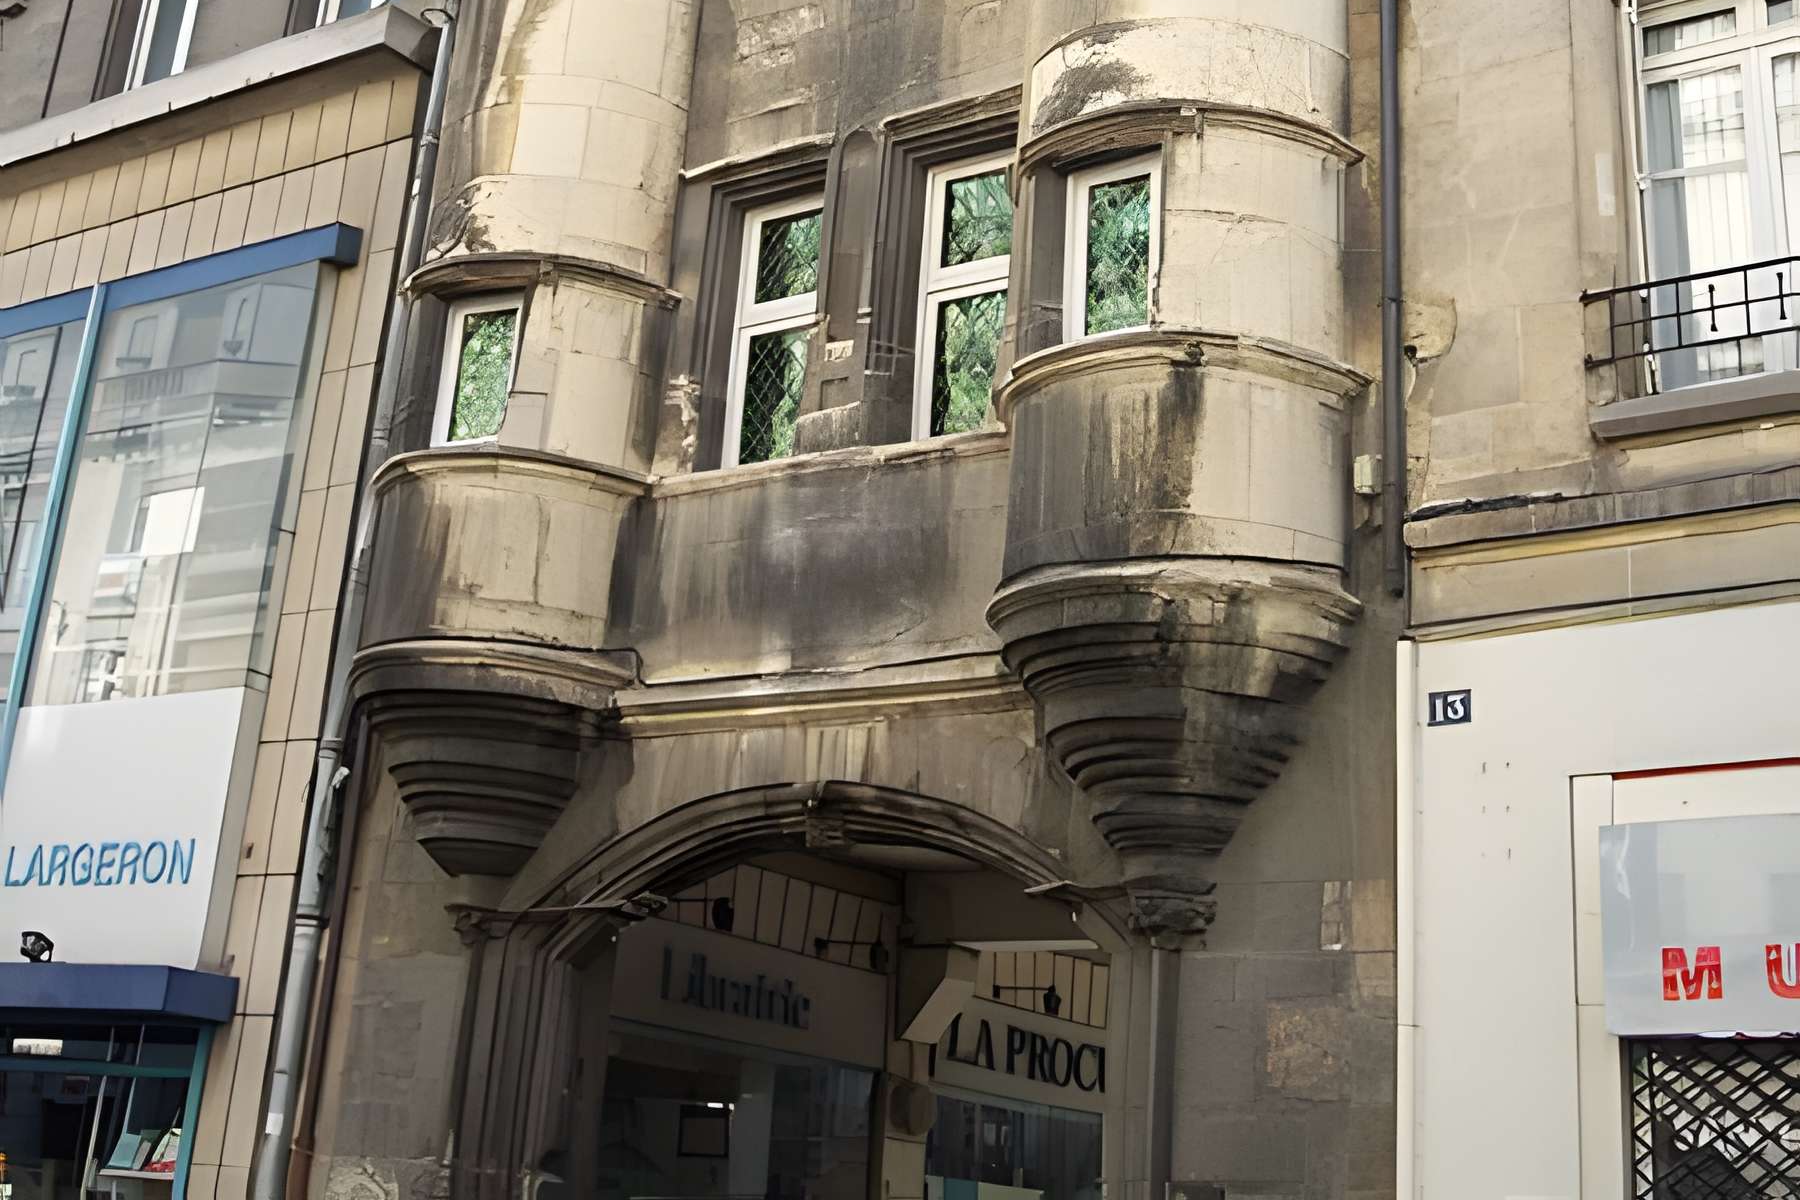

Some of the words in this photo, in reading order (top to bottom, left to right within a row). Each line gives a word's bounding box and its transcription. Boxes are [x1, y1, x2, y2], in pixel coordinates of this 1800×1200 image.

[1435, 693, 1465, 722] 13
[4, 838, 196, 887] LARGERON
[946, 1012, 996, 1071] LA
